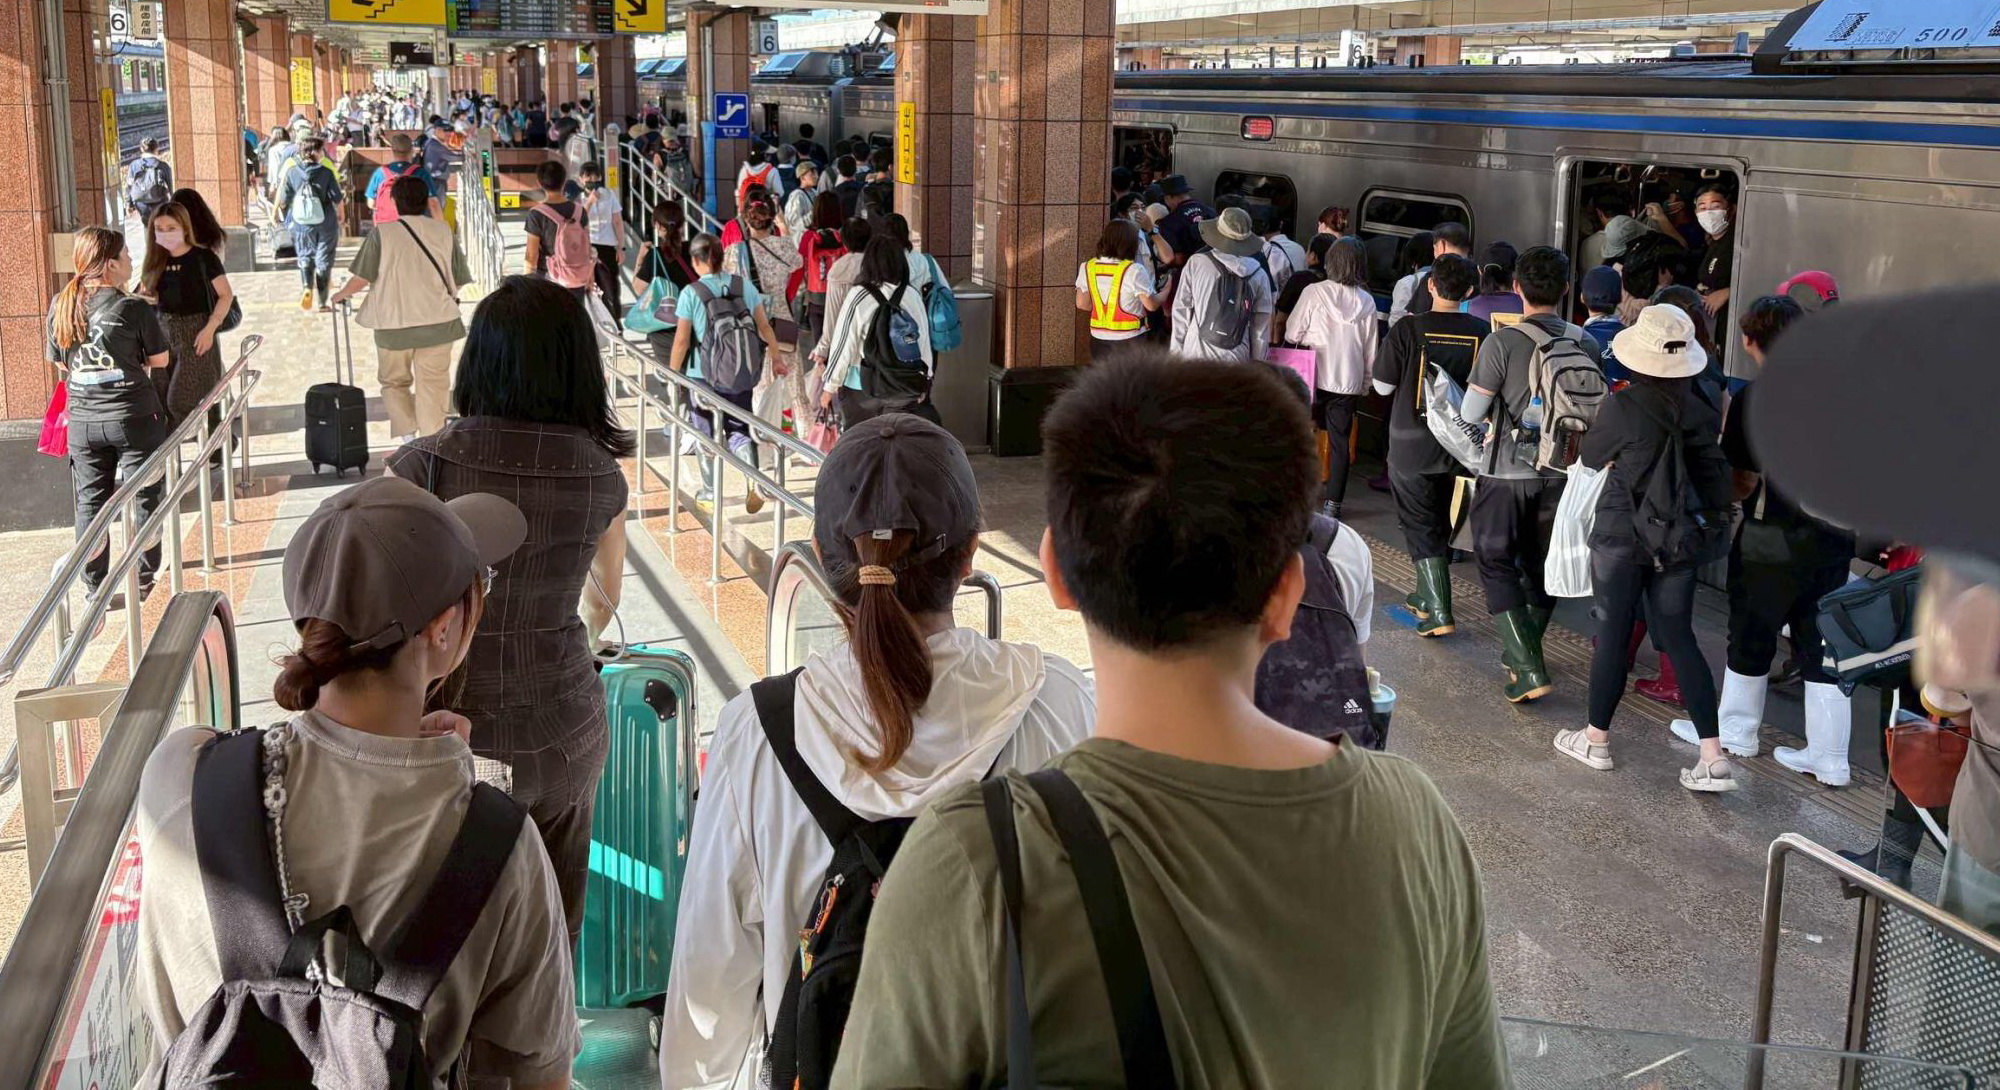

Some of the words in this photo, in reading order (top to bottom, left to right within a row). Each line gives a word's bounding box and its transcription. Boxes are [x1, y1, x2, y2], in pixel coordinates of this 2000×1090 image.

[111, 13, 126, 31] 6
[1914, 27, 1969, 42] 500
[763, 35, 775, 52] 6
[1353, 44, 1363, 60] 6
